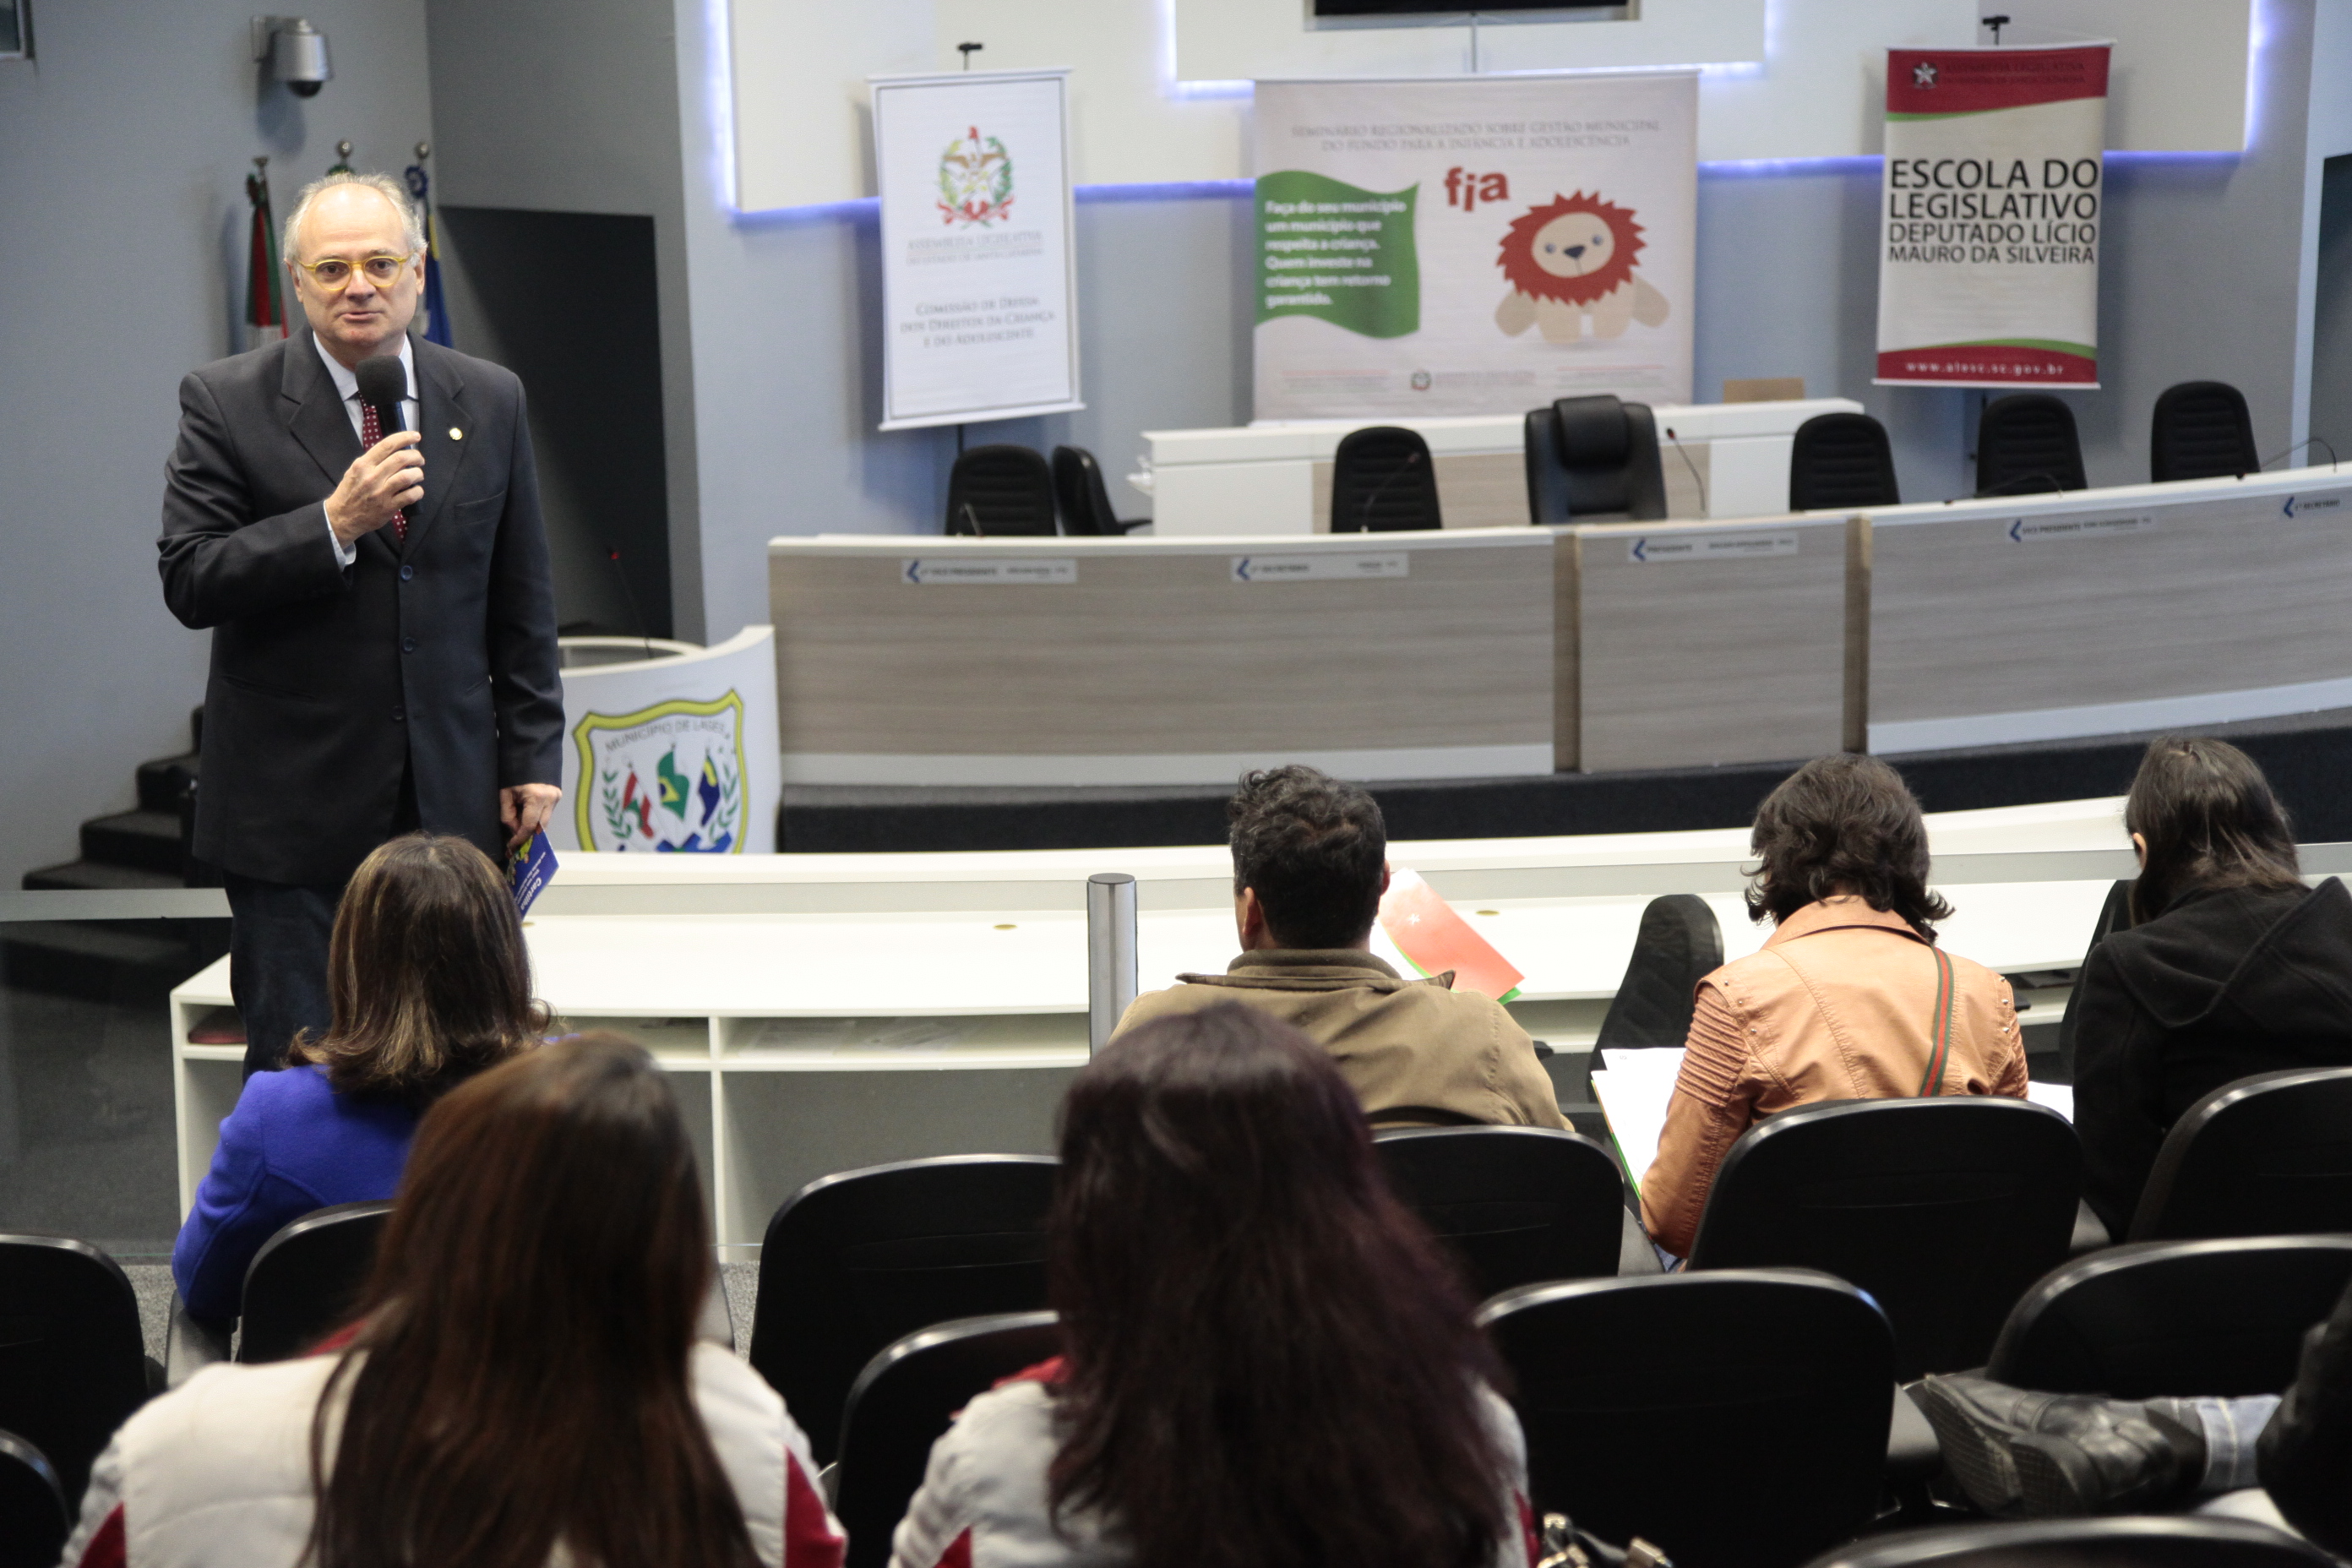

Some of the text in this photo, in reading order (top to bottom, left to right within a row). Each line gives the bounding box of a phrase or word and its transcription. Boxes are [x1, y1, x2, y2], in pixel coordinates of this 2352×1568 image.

[1891, 159, 2099, 189] ESCOLA DO
[1265, 199, 1407, 216] Faça do seu município
[1890, 193, 2098, 220] LEGISLATIVO
[1265, 218, 1382, 234] um município que
[1889, 219, 2096, 243] DEPUTADO LÍCIO
[1265, 237, 1319, 253] respeita
[1888, 245, 2095, 264] MAURO DA SILVEIRA
[1265, 256, 1305, 270] Quem
[1355, 257, 1373, 268] na
[1265, 275, 1311, 290] criança
[1314, 275, 1339, 287] tem
[1905, 361, 2064, 377] www.alesc.sc.gov.br
